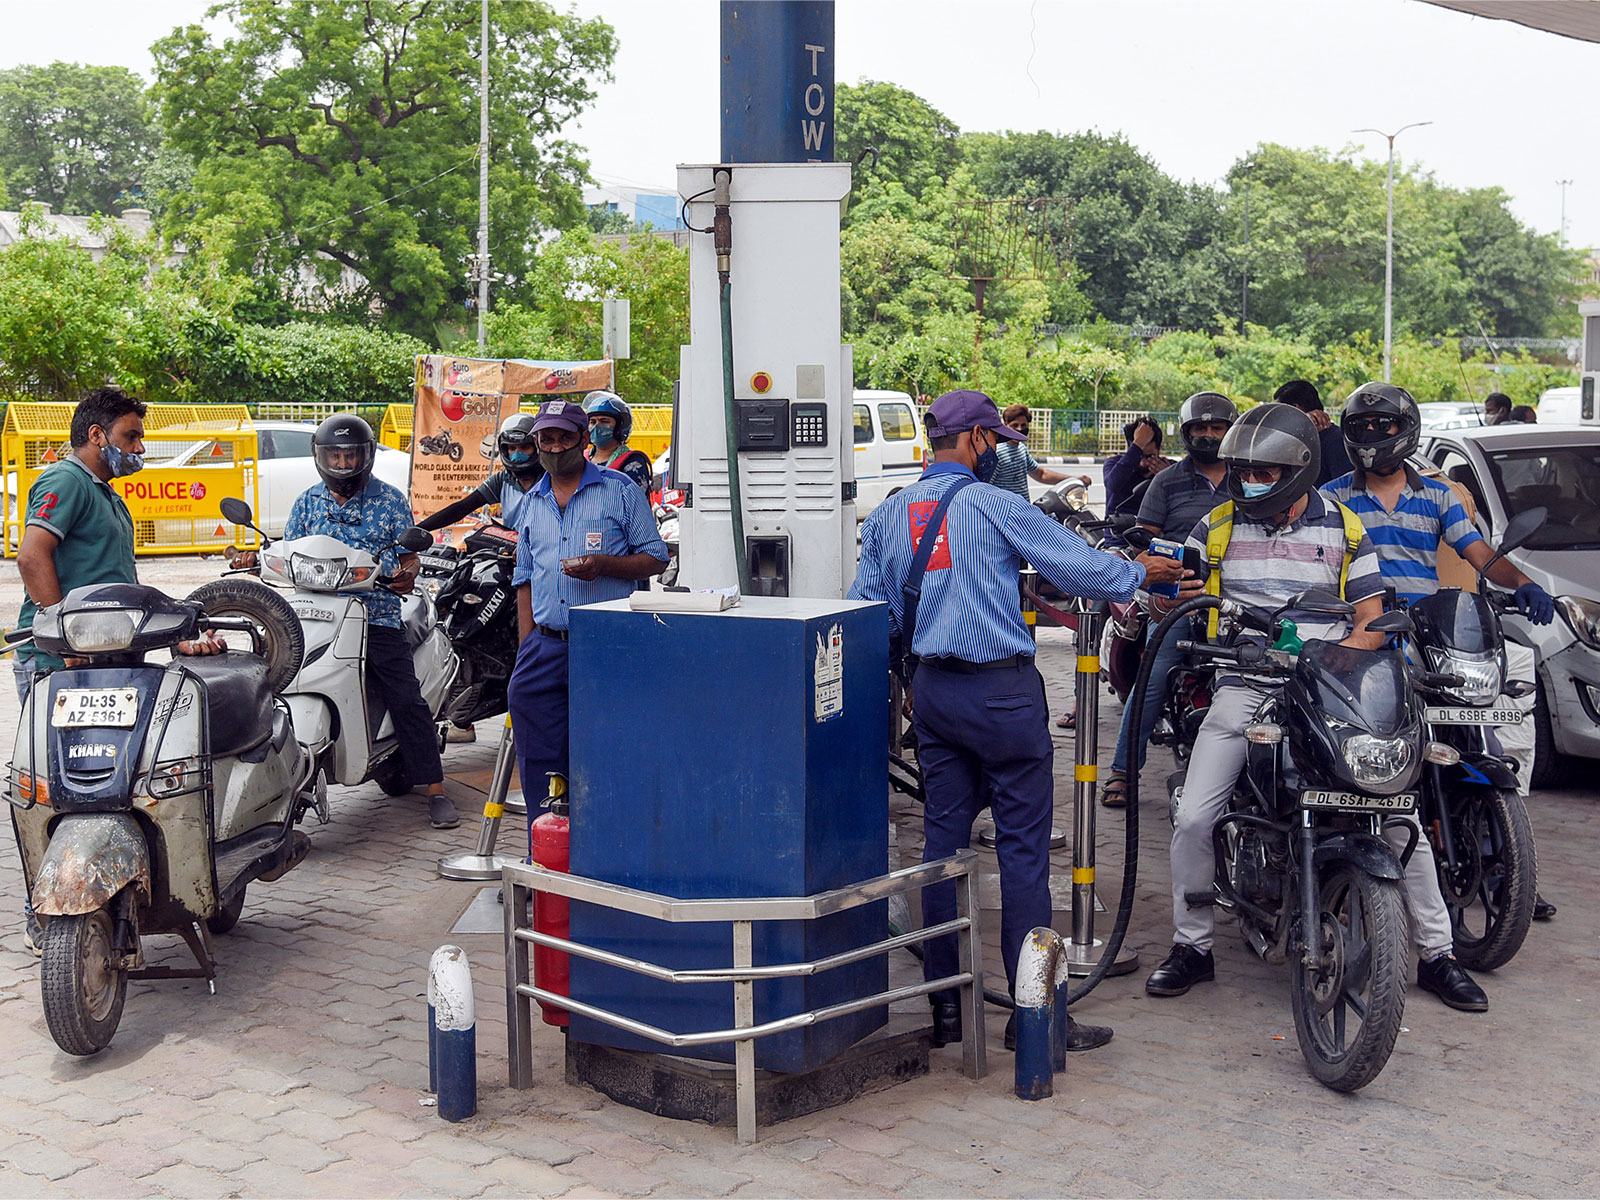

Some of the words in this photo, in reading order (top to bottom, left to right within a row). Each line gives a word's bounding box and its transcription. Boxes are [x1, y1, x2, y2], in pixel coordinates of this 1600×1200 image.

[452, 360, 470, 373] Euro
[557, 375, 578, 387] Gold
[461, 397, 498, 416] Gold
[415, 463, 435, 471] WORLD
[124, 482, 188, 499] POLICE
[36, 493, 58, 520] 2
[165, 504, 193, 514] ESTATE
[81, 600, 121, 608] HONDA
[478, 588, 505, 625] MUKKU
[67, 710, 86, 723] AZ
[91, 710, 123, 723] 5361
[1439, 709, 1454, 721] DL
[1459, 710, 1487, 721] 6SBE
[1492, 711, 1520, 721] 8896
[68, 744, 116, 759] KHAN'S
[1317, 793, 1333, 805] DL
